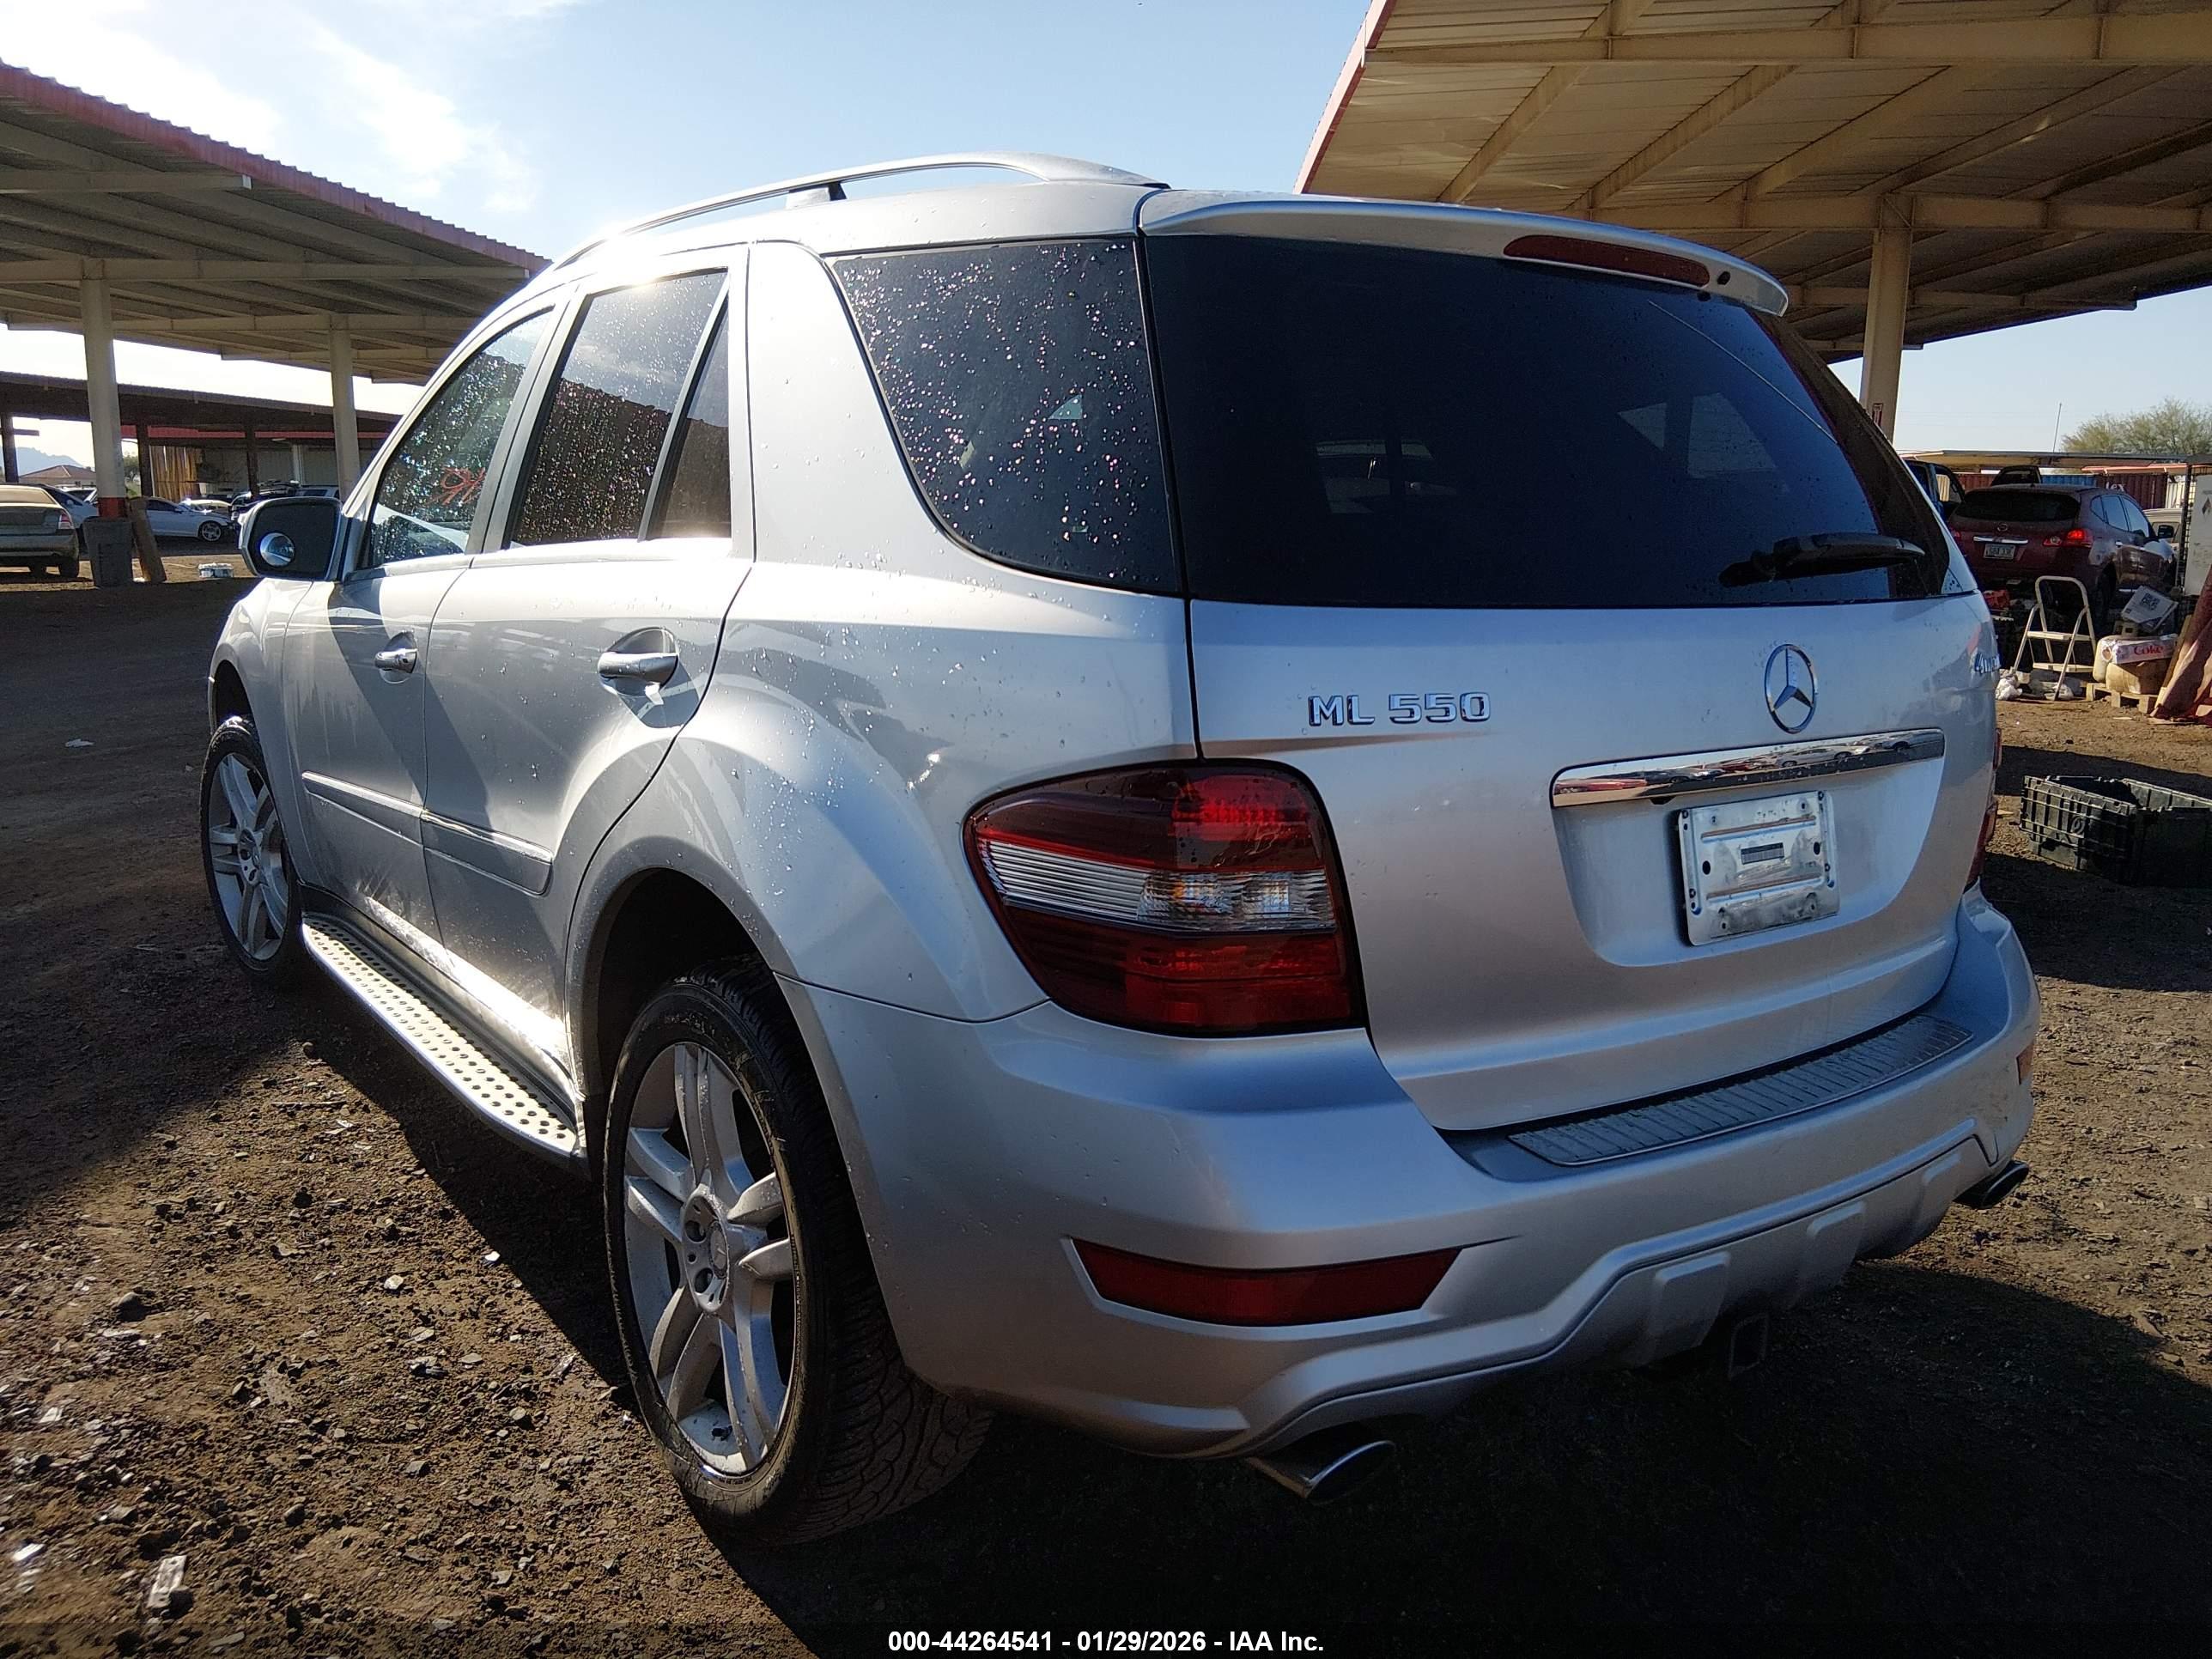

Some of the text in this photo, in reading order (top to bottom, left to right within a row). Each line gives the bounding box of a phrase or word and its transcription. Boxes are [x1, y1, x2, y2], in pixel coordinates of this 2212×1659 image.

[2134, 645, 2164, 656] Coke
[1308, 691, 1491, 726] ML 550
